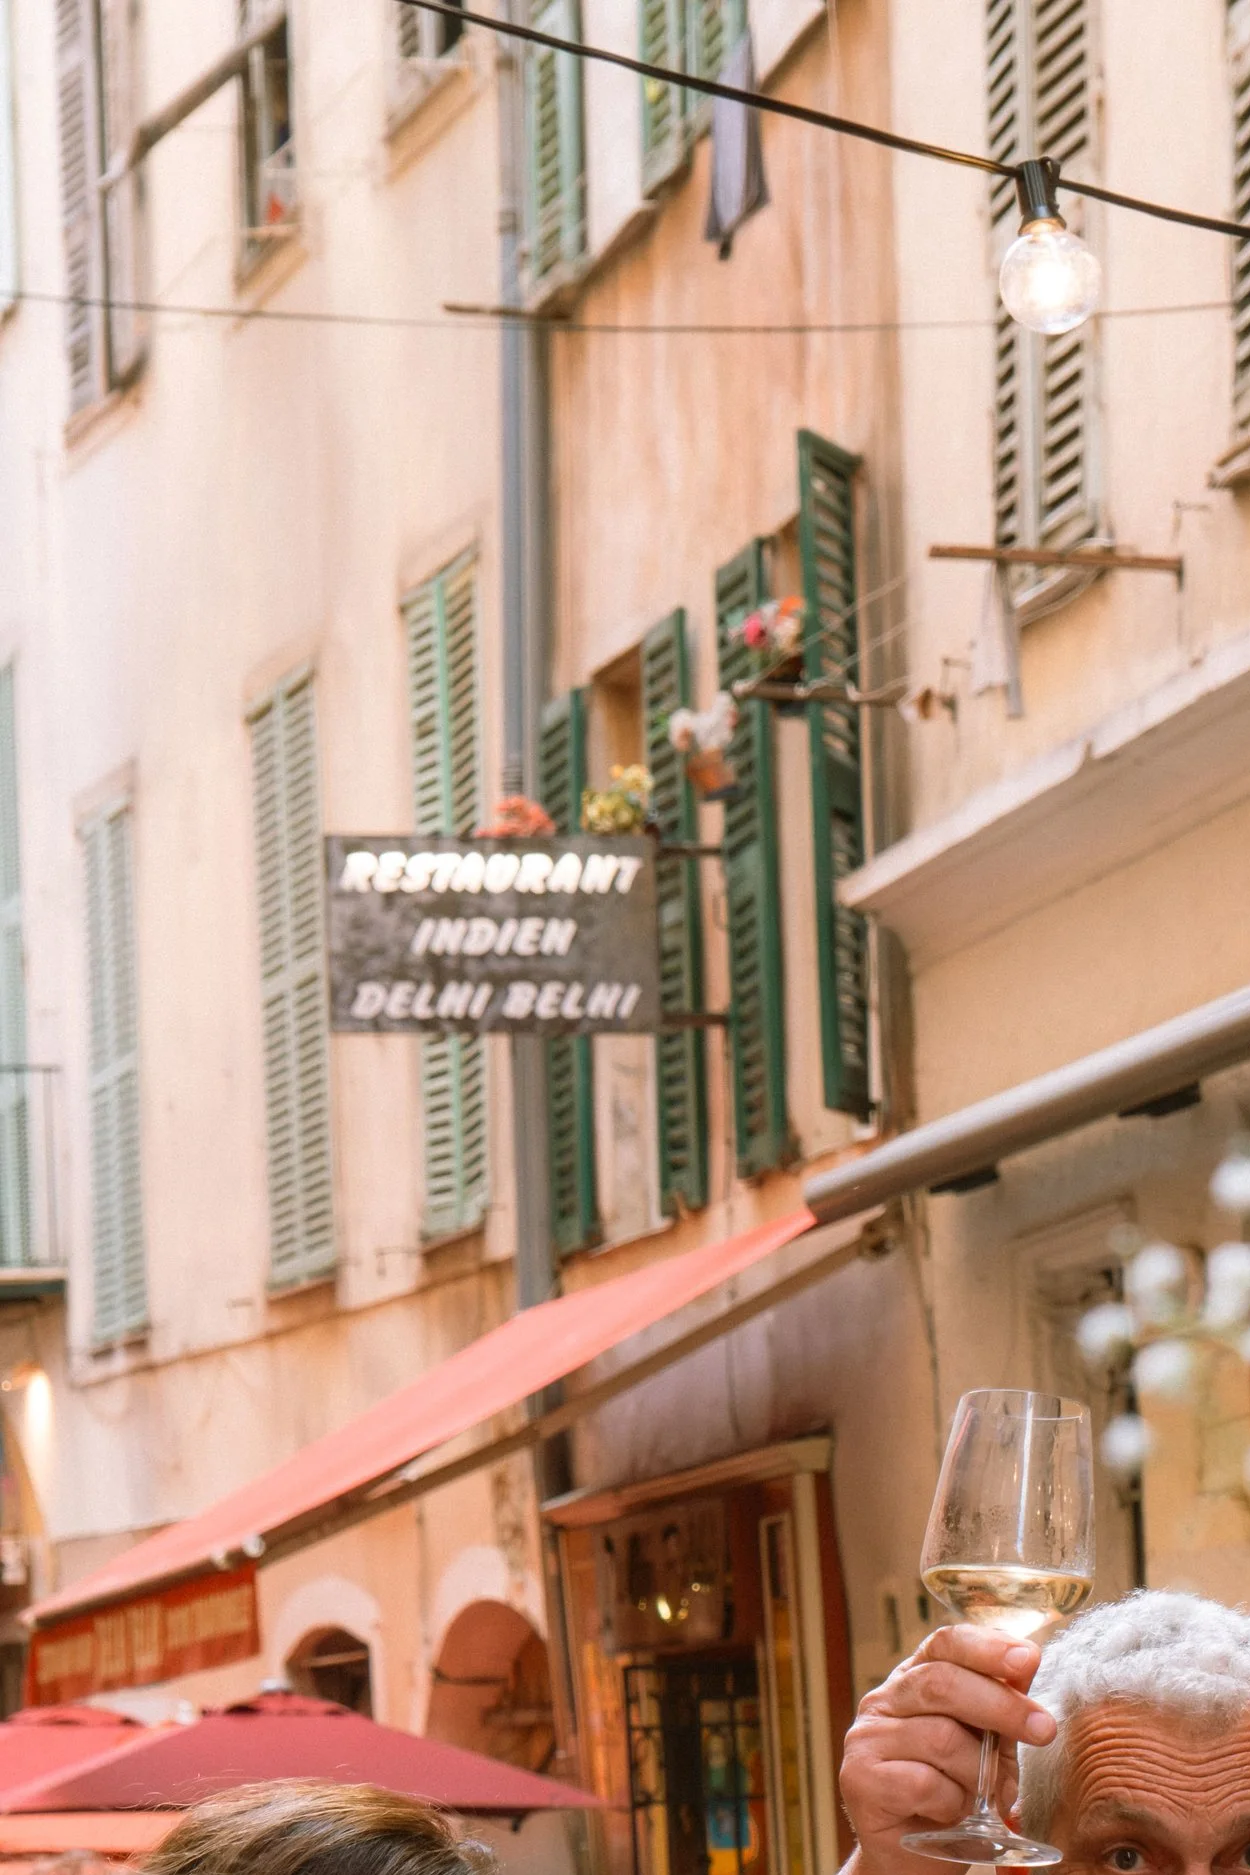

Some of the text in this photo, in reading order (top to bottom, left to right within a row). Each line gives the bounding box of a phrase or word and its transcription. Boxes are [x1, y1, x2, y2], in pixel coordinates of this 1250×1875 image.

[340, 851, 642, 894] RESTAURANT
[410, 916, 577, 956] INDIEN
[350, 980, 493, 1020] DELHI
